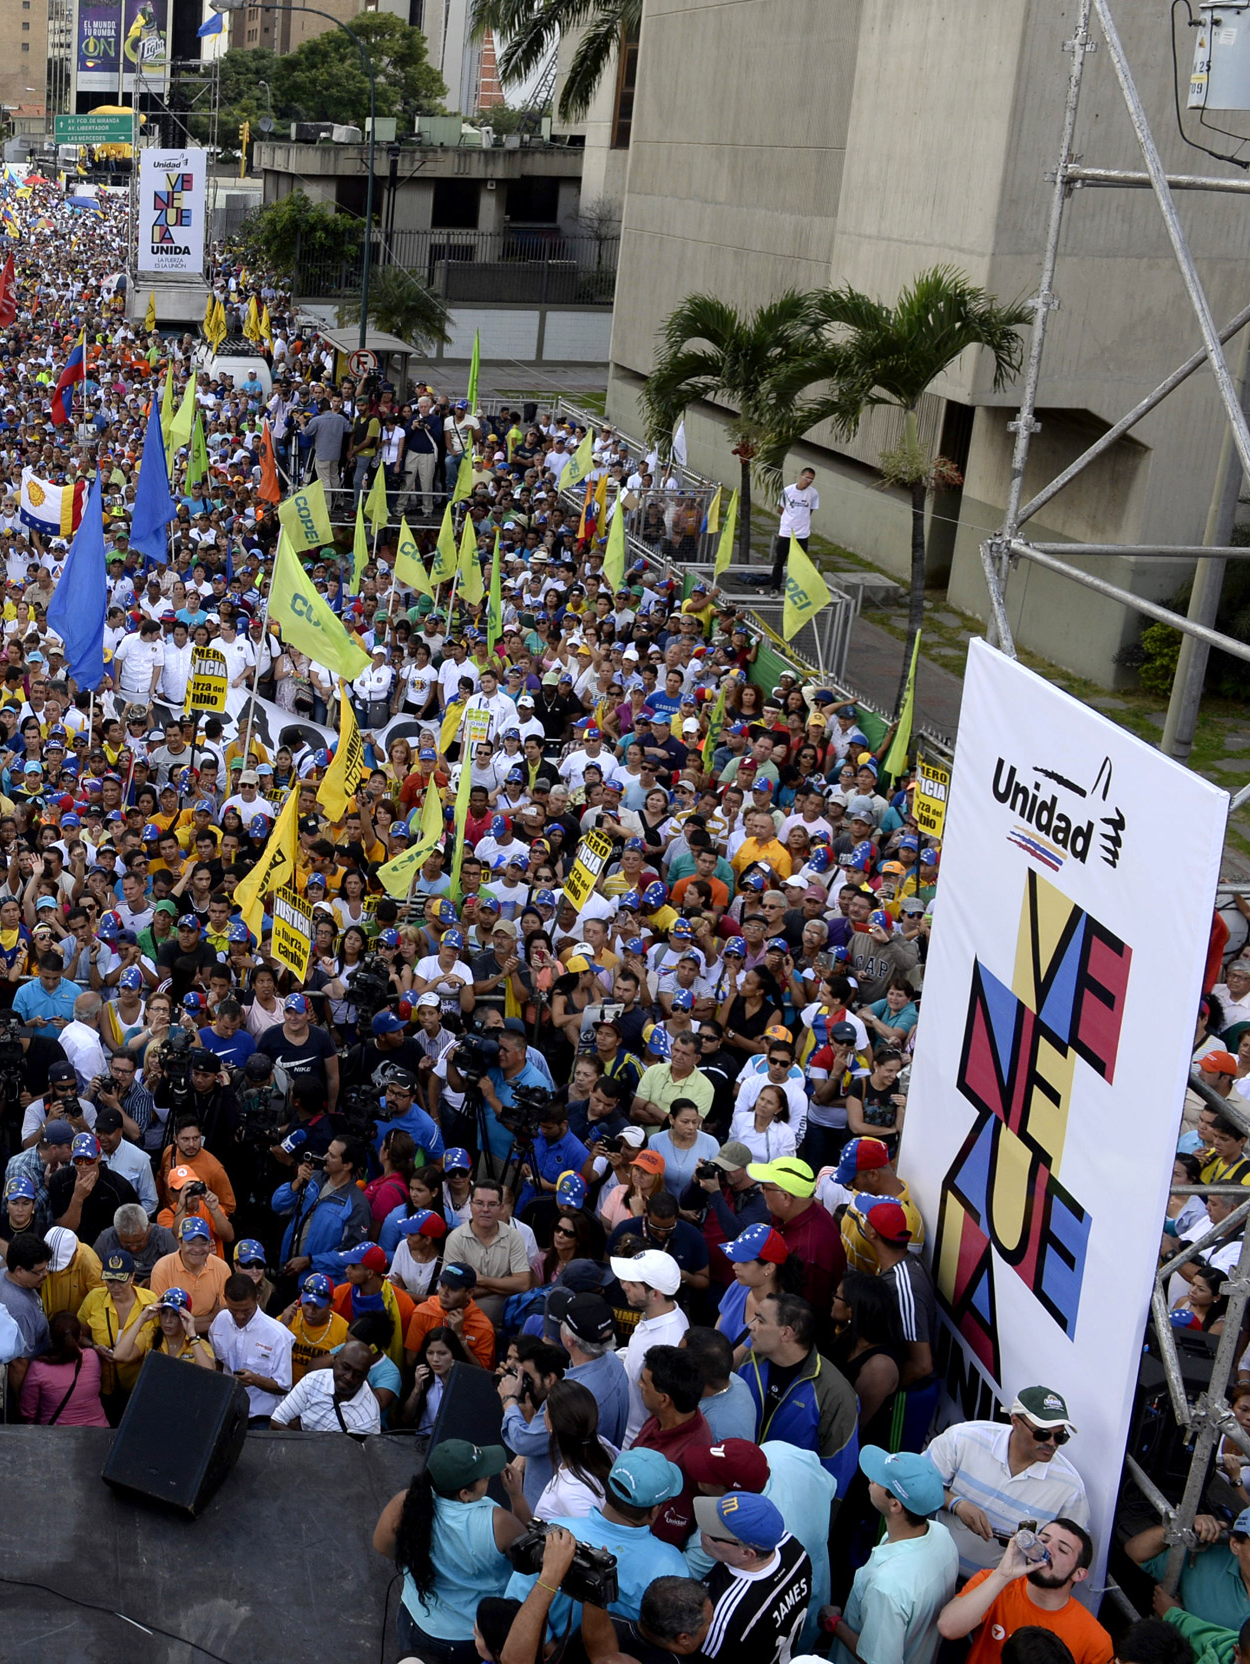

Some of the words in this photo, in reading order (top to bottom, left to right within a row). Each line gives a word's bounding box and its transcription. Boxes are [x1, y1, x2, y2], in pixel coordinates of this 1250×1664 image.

[84, 20, 91, 29] EL
[84, 28, 92, 36] TU
[82, 37, 115, 57] ON
[139, 36, 165, 60] Light
[153, 161, 181, 169] Unidad
[151, 245, 191, 255] UNIDA
[356, 354, 369, 373] F
[295, 496, 320, 544] COPEI
[785, 576, 813, 611] PEI
[195, 647, 226, 662] MERO
[195, 659, 227, 678] TICIA
[192, 681, 212, 692] erza
[213, 685, 224, 693] del
[919, 801, 931, 814] rza
[931, 808, 942, 818] del
[992, 756, 1095, 865] Unidad
[919, 813, 936, 830] bio
[571, 866, 583, 884] rza
[580, 879, 590, 892] del
[276, 886, 312, 918] PRIMERO
[275, 897, 310, 940] JUSTICIA
[275, 927, 281, 937] La
[281, 927, 302, 950] fuerza
[301, 945, 309, 957] del
[278, 942, 304, 972] cambio
[854, 955, 889, 979] GAP
[292, 1343, 330, 1357] RIMERO
[771, 1577, 808, 1629] JAMES
